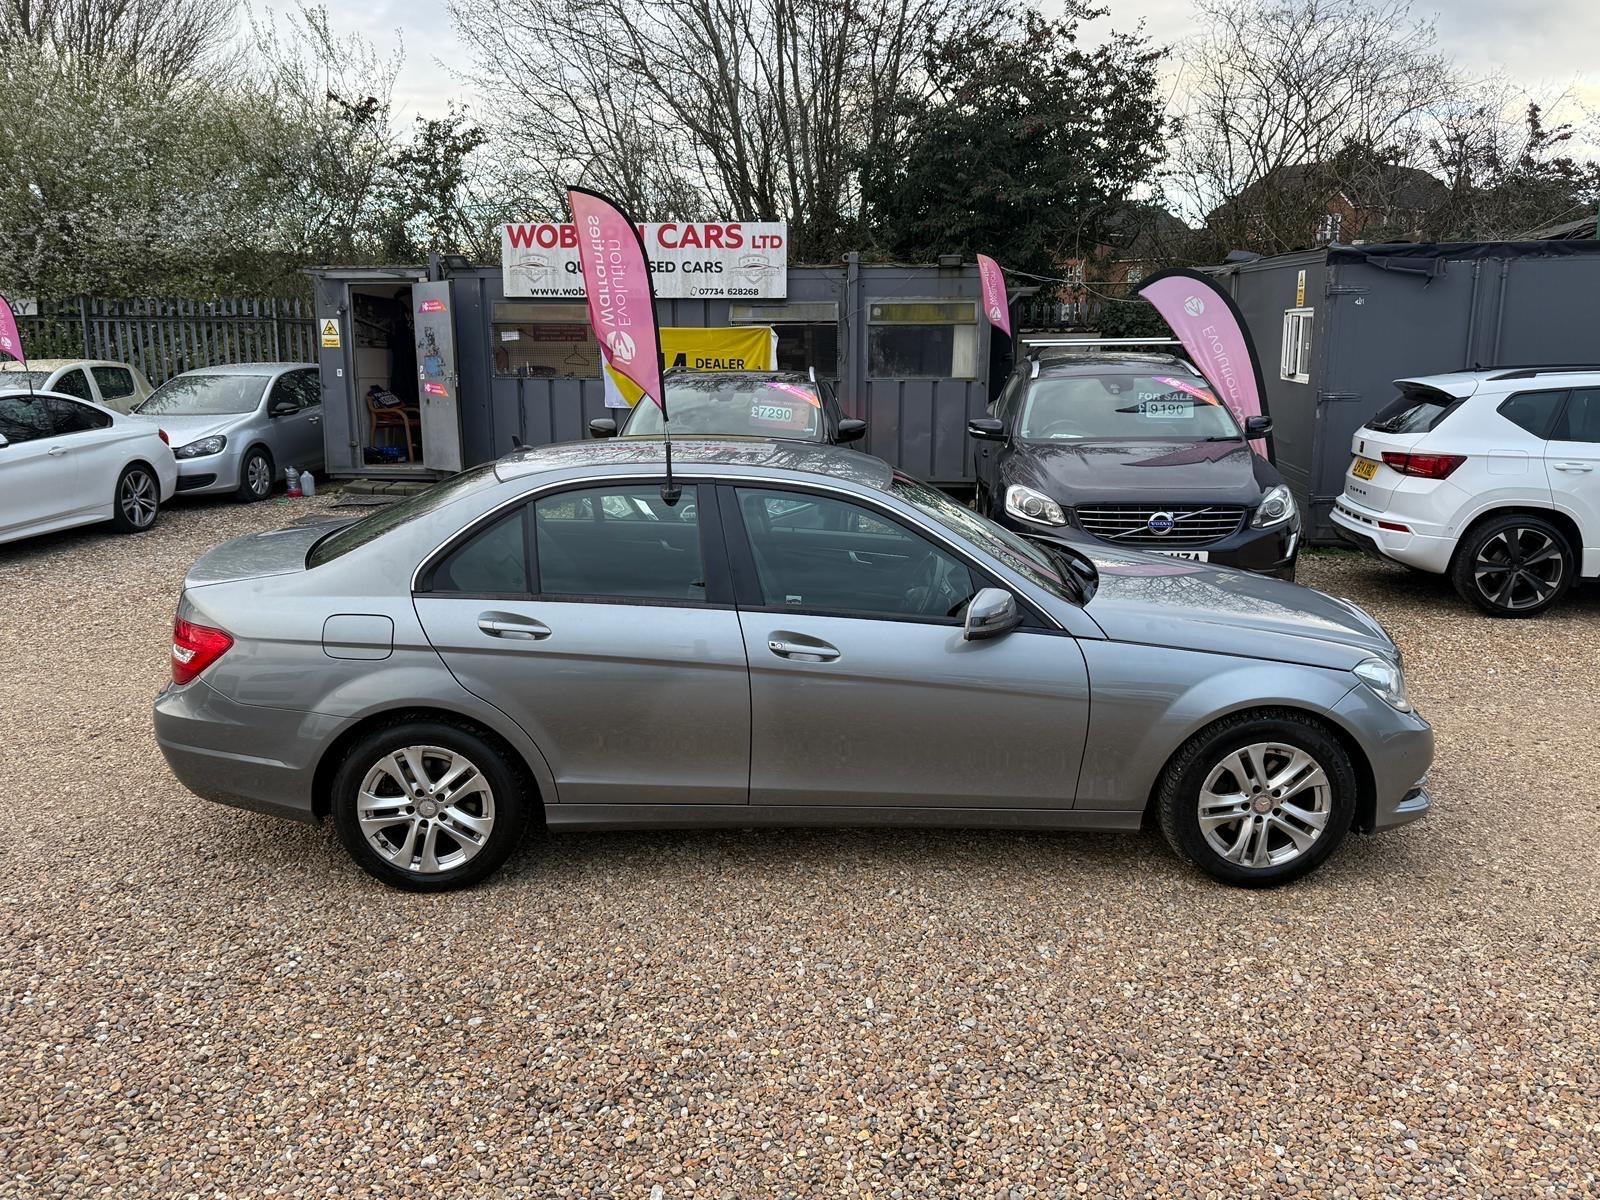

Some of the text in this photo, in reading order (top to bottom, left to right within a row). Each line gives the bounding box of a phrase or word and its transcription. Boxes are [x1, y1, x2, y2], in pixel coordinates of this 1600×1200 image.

[657, 223, 744, 249] CARS
[752, 235, 783, 249] LTD
[649, 261, 676, 273] SED
[682, 261, 723, 273] CARS
[698, 288, 759, 296] 07734 628268
[695, 358, 745, 370] DEALER
[1138, 392, 1193, 401] FOR SALE
